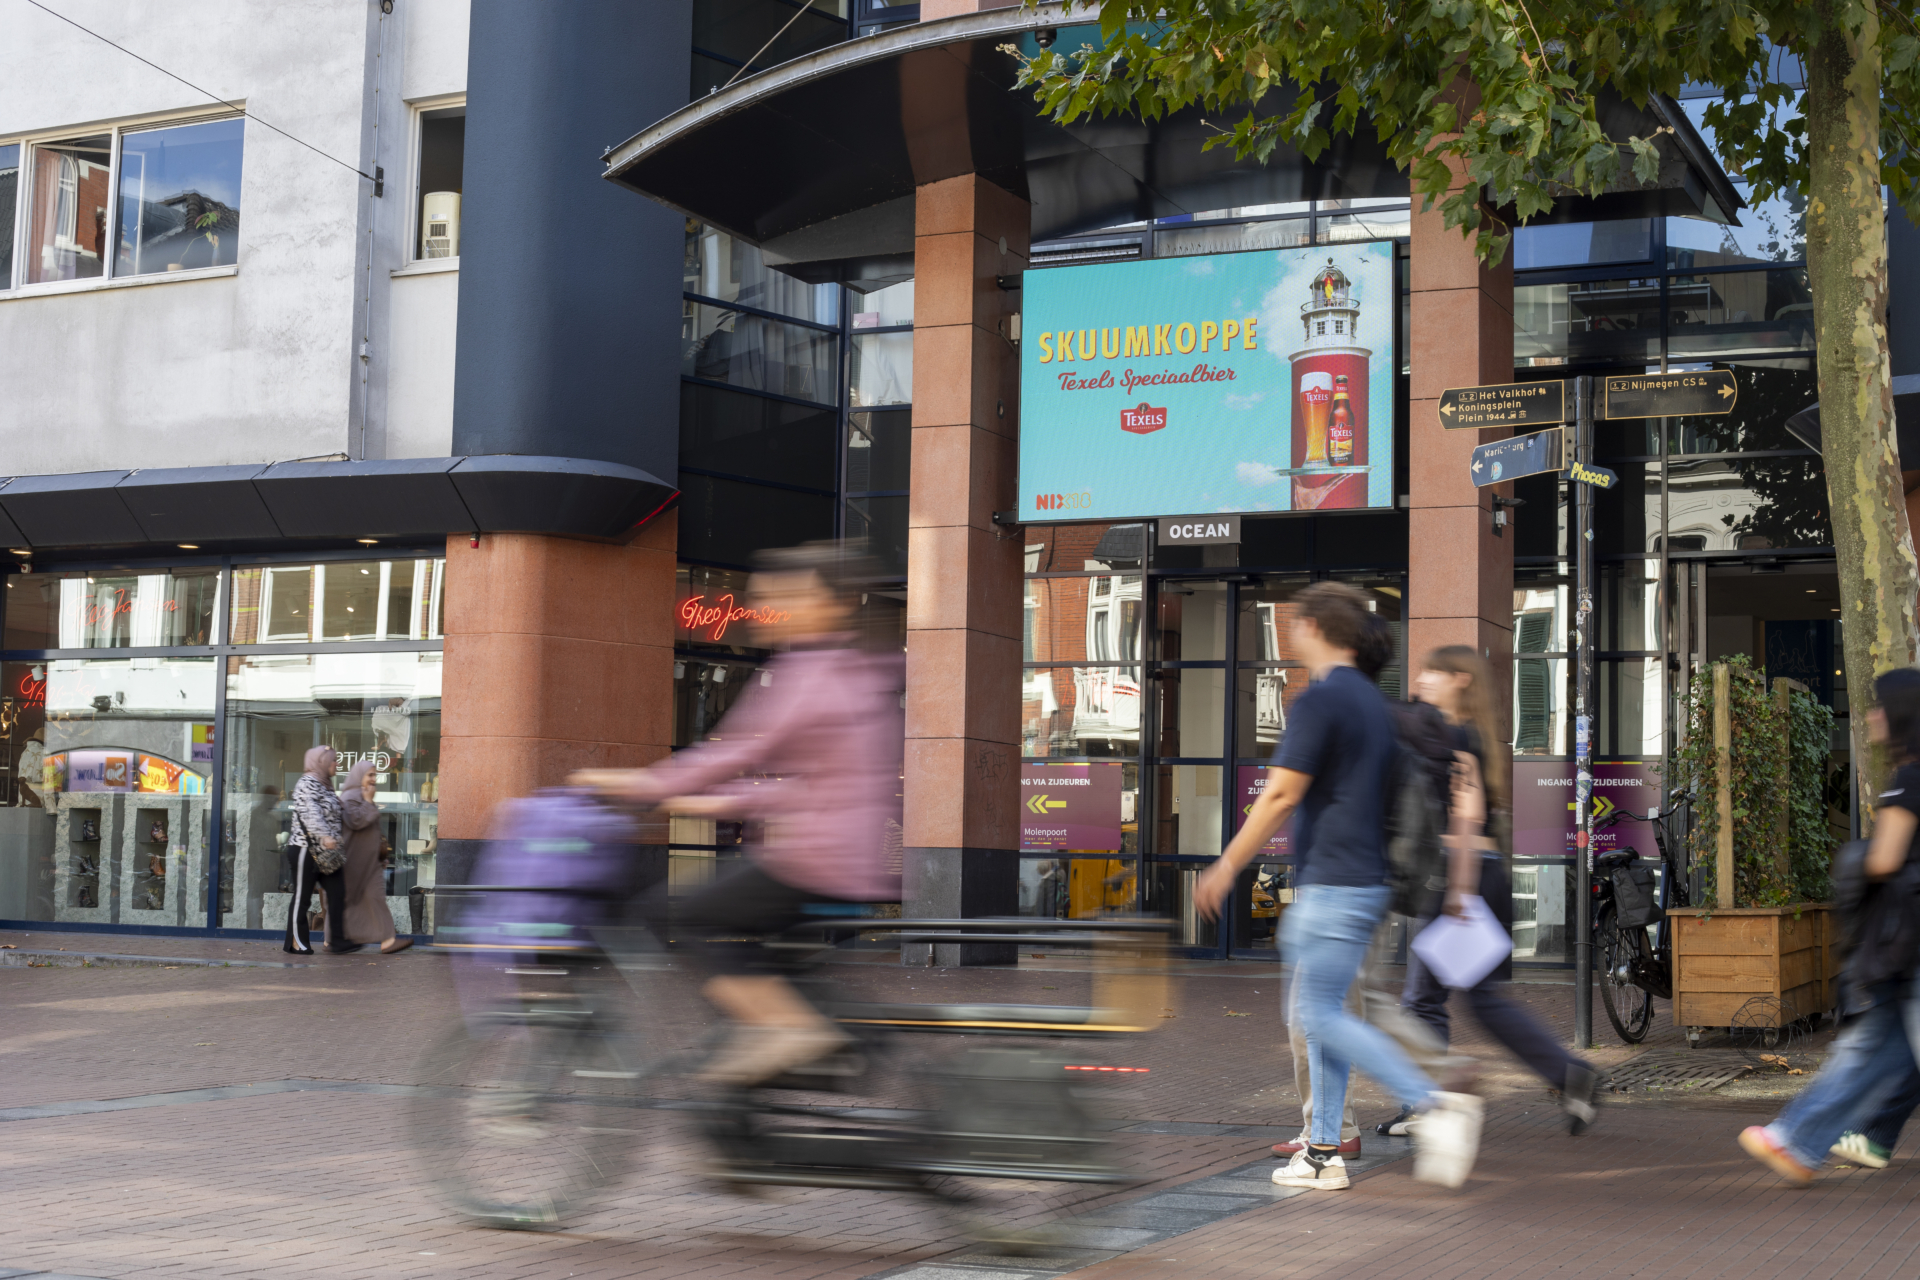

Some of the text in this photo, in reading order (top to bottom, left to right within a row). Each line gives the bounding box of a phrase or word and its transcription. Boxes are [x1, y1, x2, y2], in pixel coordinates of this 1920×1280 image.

[1038, 318, 1257, 364] SKUUMKOPPE
[1058, 364, 1237, 395] Texels Speciaalbier
[1631, 380, 1679, 391] Nijmegen
[1683, 378, 1696, 387] CS
[1305, 392, 1329, 402] TEXELS
[1479, 391, 1497, 400] Het
[1499, 387, 1537, 399] Valkhof
[1458, 400, 1522, 412] Koningsplein
[1123, 411, 1164, 427] TEXELS
[1458, 412, 1505, 423] Plein 1944
[1330, 428, 1352, 438] TEXELS
[1570, 461, 1611, 487] Phocas
[1036, 492, 1092, 510] NIX18
[1169, 523, 1230, 539] OCEAN
[682, 594, 792, 641] Theo Jansen
[1033, 778, 1047, 786] VIA
[1537, 778, 1573, 787] INGANG
[1024, 827, 1067, 838] Molenpoort
[1566, 832, 1616, 842] Mopoort
